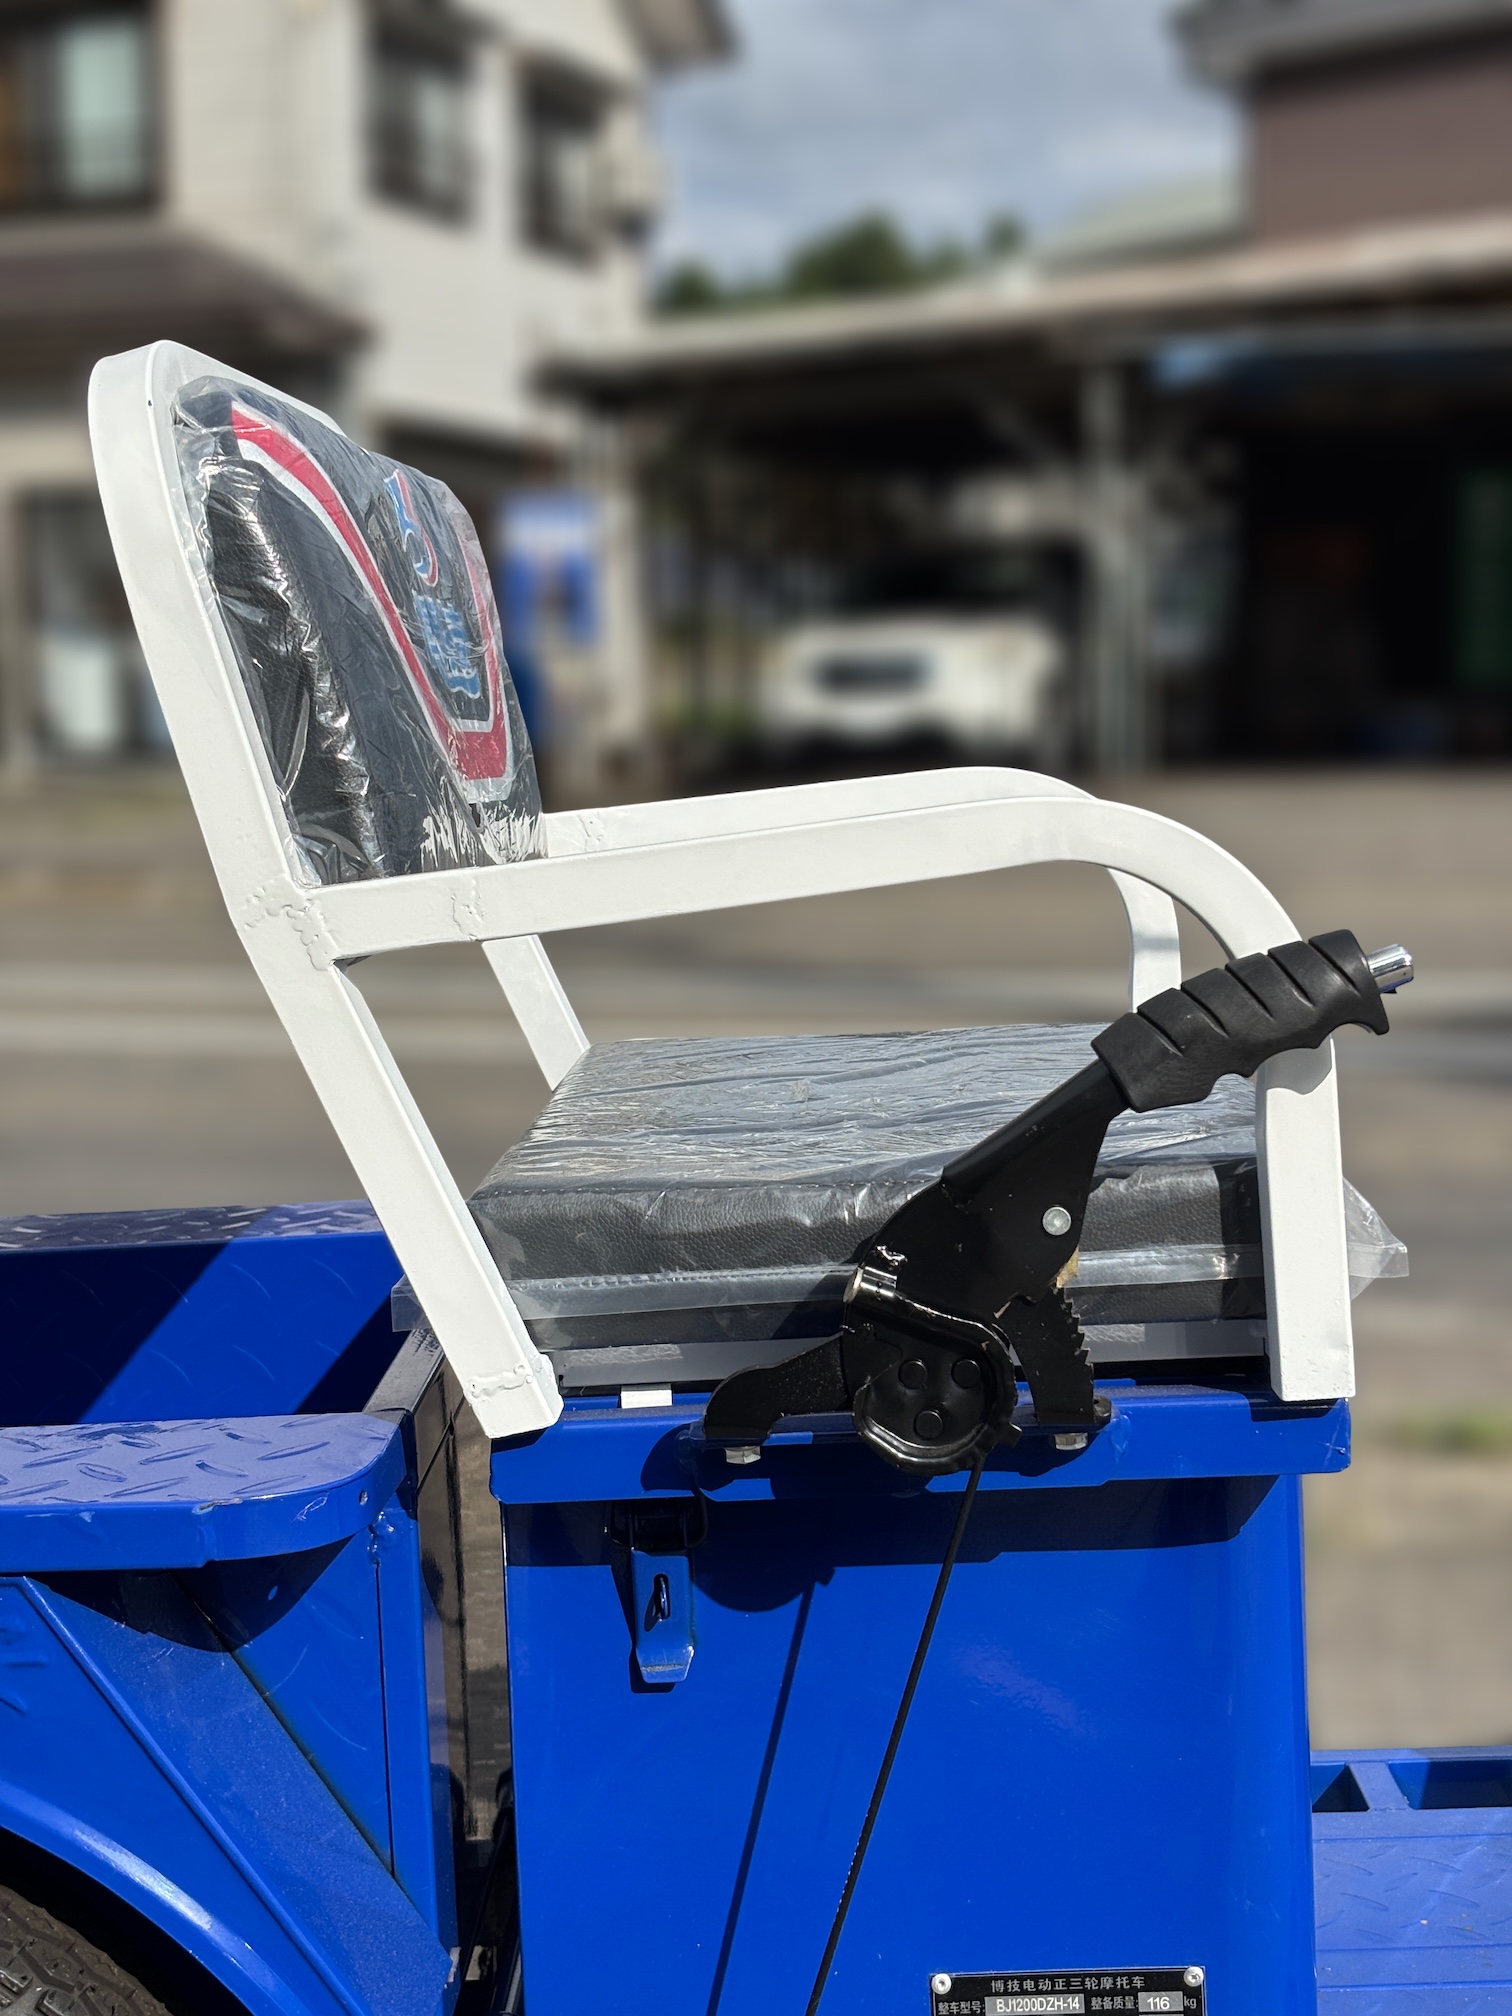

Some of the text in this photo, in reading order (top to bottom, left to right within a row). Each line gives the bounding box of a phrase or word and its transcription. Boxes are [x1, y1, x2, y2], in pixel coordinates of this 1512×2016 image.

[990, 1976, 1146, 1993] 博技电动正三轮摩托车
[996, 1997, 1080, 2014] BJ1200DZH-14
[1147, 1996, 1170, 2011] 116
[1184, 1996, 1197, 2009] kg
